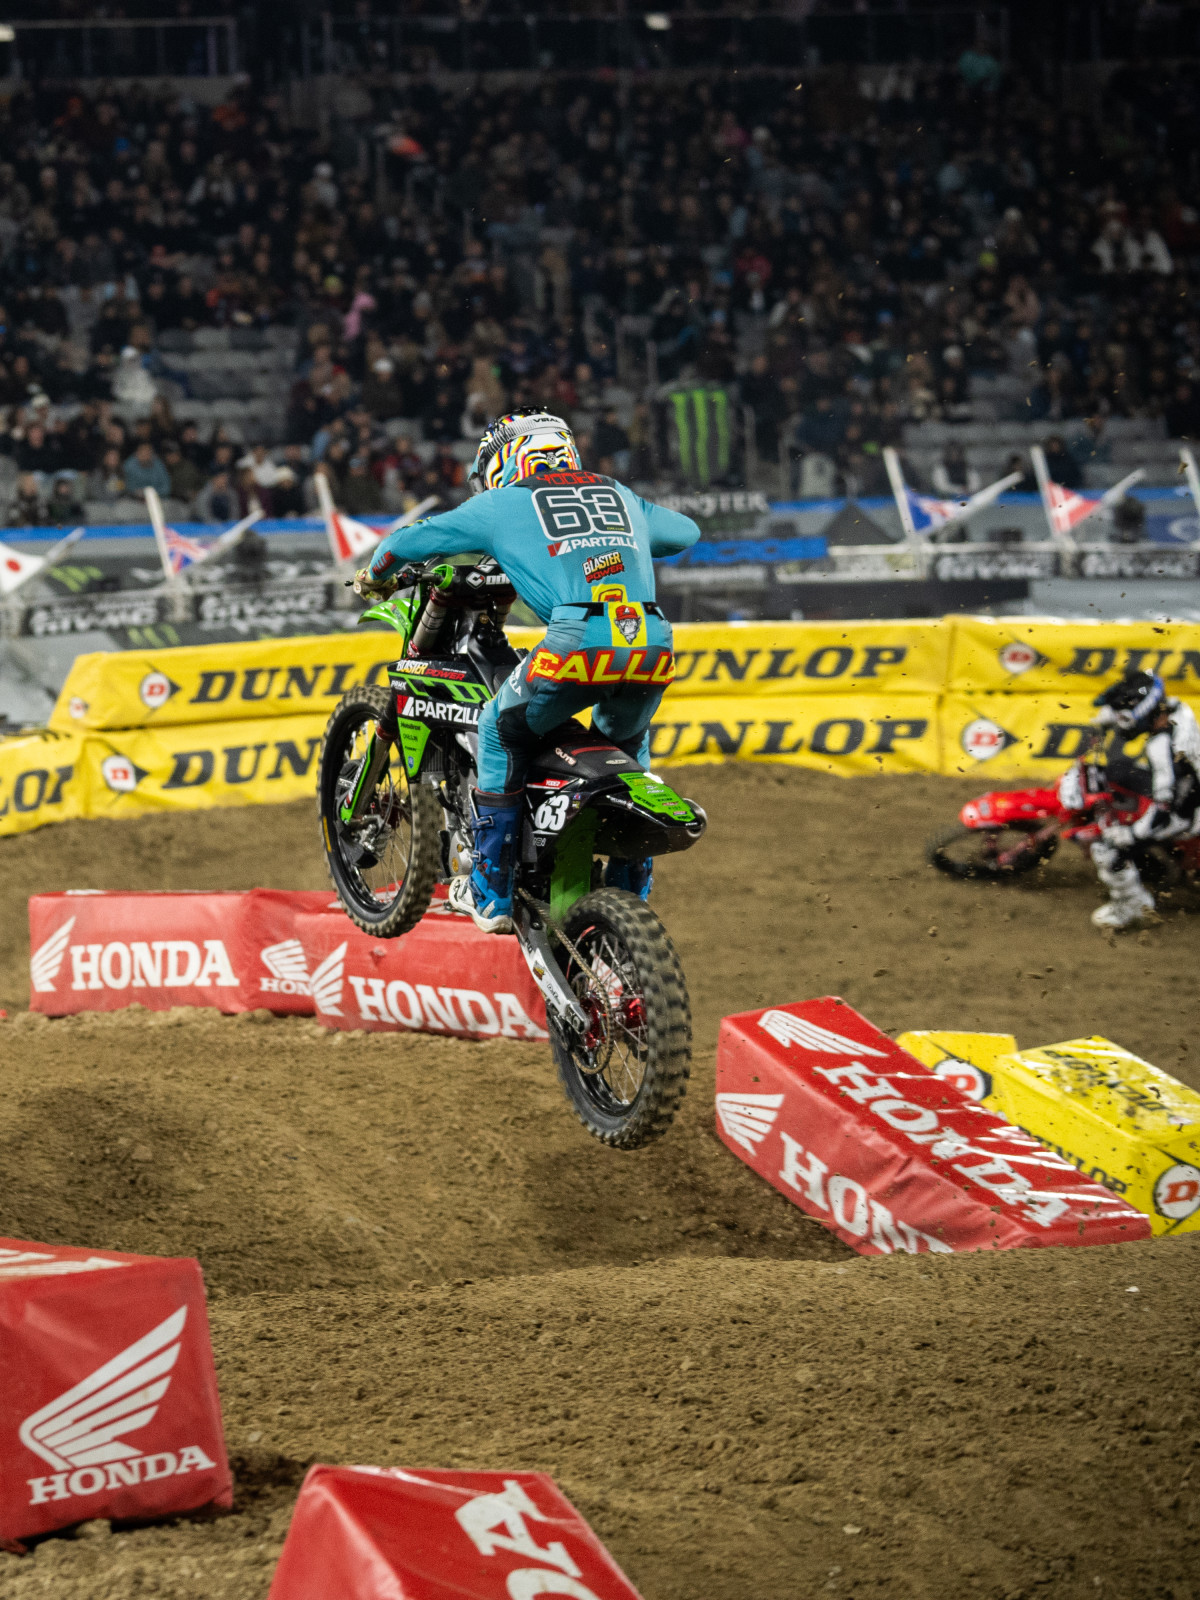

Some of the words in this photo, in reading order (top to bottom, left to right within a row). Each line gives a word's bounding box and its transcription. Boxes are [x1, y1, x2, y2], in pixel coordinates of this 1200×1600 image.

[530, 485, 635, 541] 63
[570, 536, 640, 552] PARTZILLA
[582, 551, 622, 576] BLASTER
[585, 563, 625, 583] POWER
[396, 660, 429, 675] BLASTER
[425, 668, 467, 681] POWER
[554, 747, 577, 766] GUTS
[534, 794, 570, 831] 63
[71, 940, 240, 990] HONDA
[348, 975, 550, 1039] HONDA
[812, 1060, 1070, 1228] HONDA
[26, 1444, 217, 1505] HONDA
